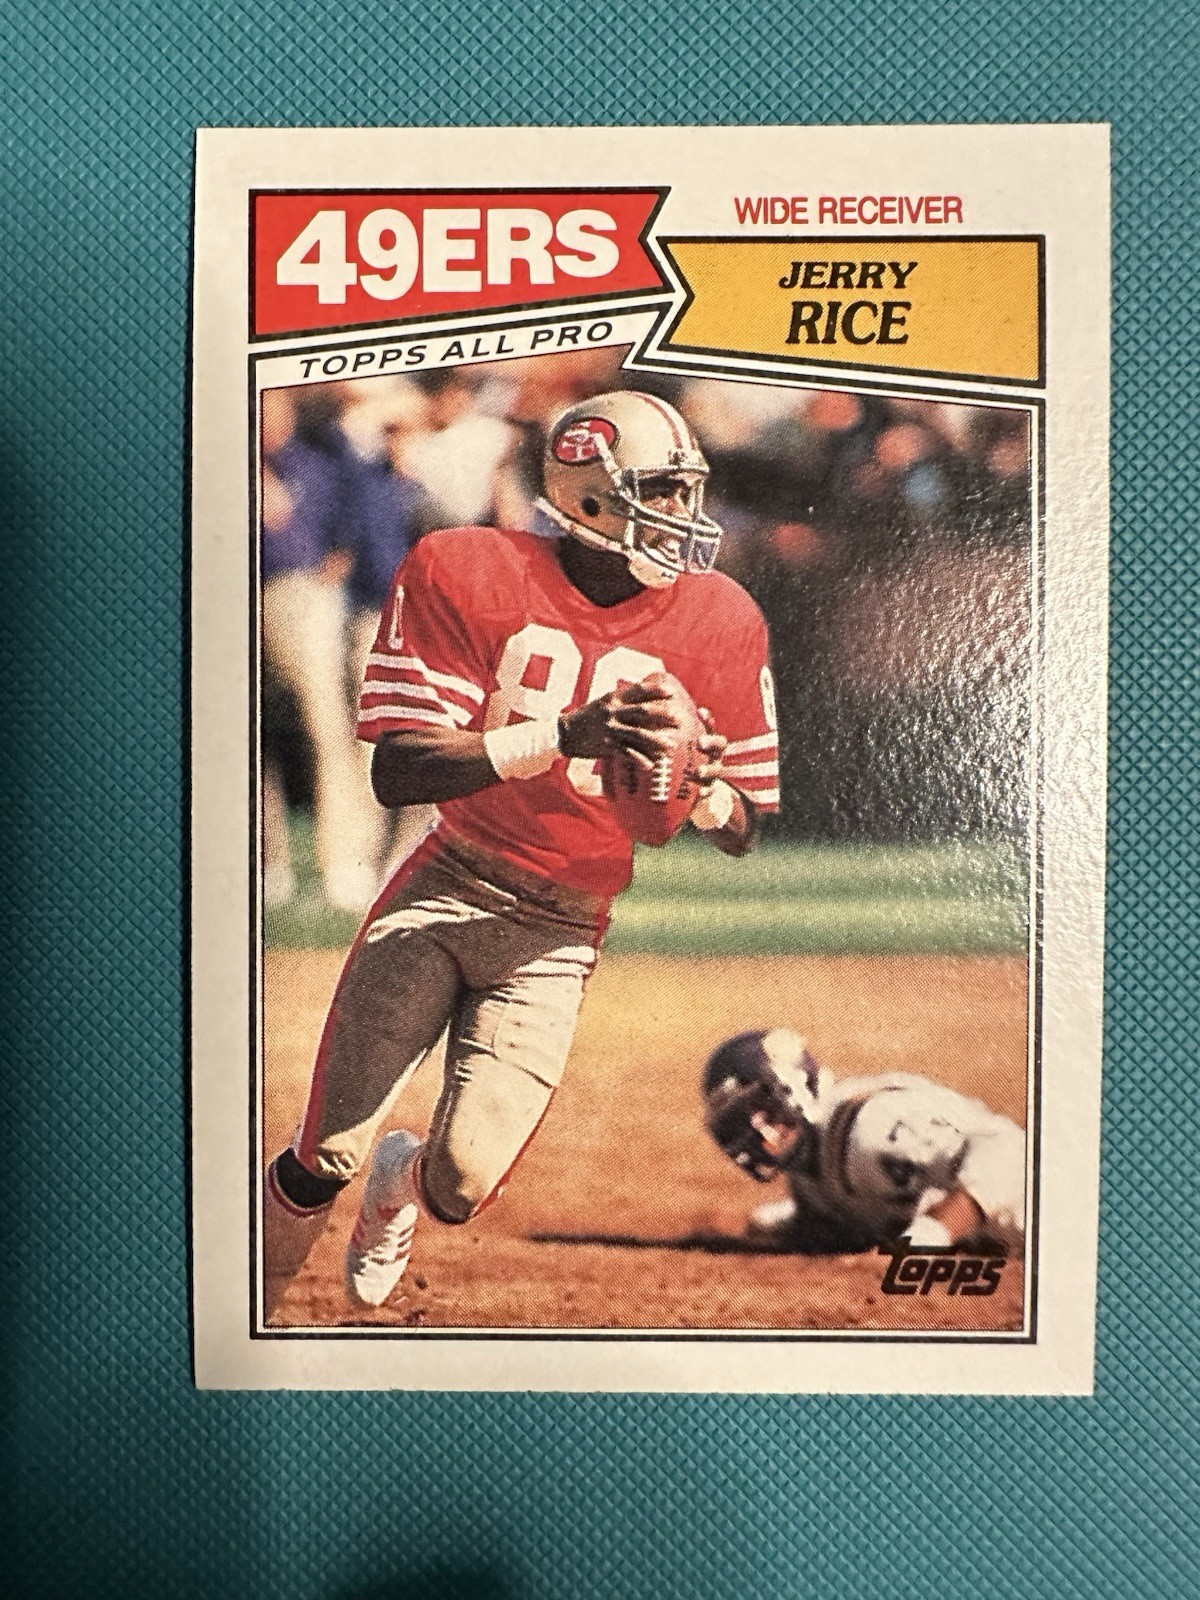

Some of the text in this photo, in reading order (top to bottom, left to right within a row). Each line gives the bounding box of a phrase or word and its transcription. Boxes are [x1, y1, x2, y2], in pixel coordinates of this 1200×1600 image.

[735, 196, 963, 224] WIDE RECEIVER
[277, 208, 620, 304] 49ERS
[779, 261, 918, 289] JERRY
[785, 301, 912, 345] RICE
[300, 322, 613, 378] TOPPS ALL PRO
